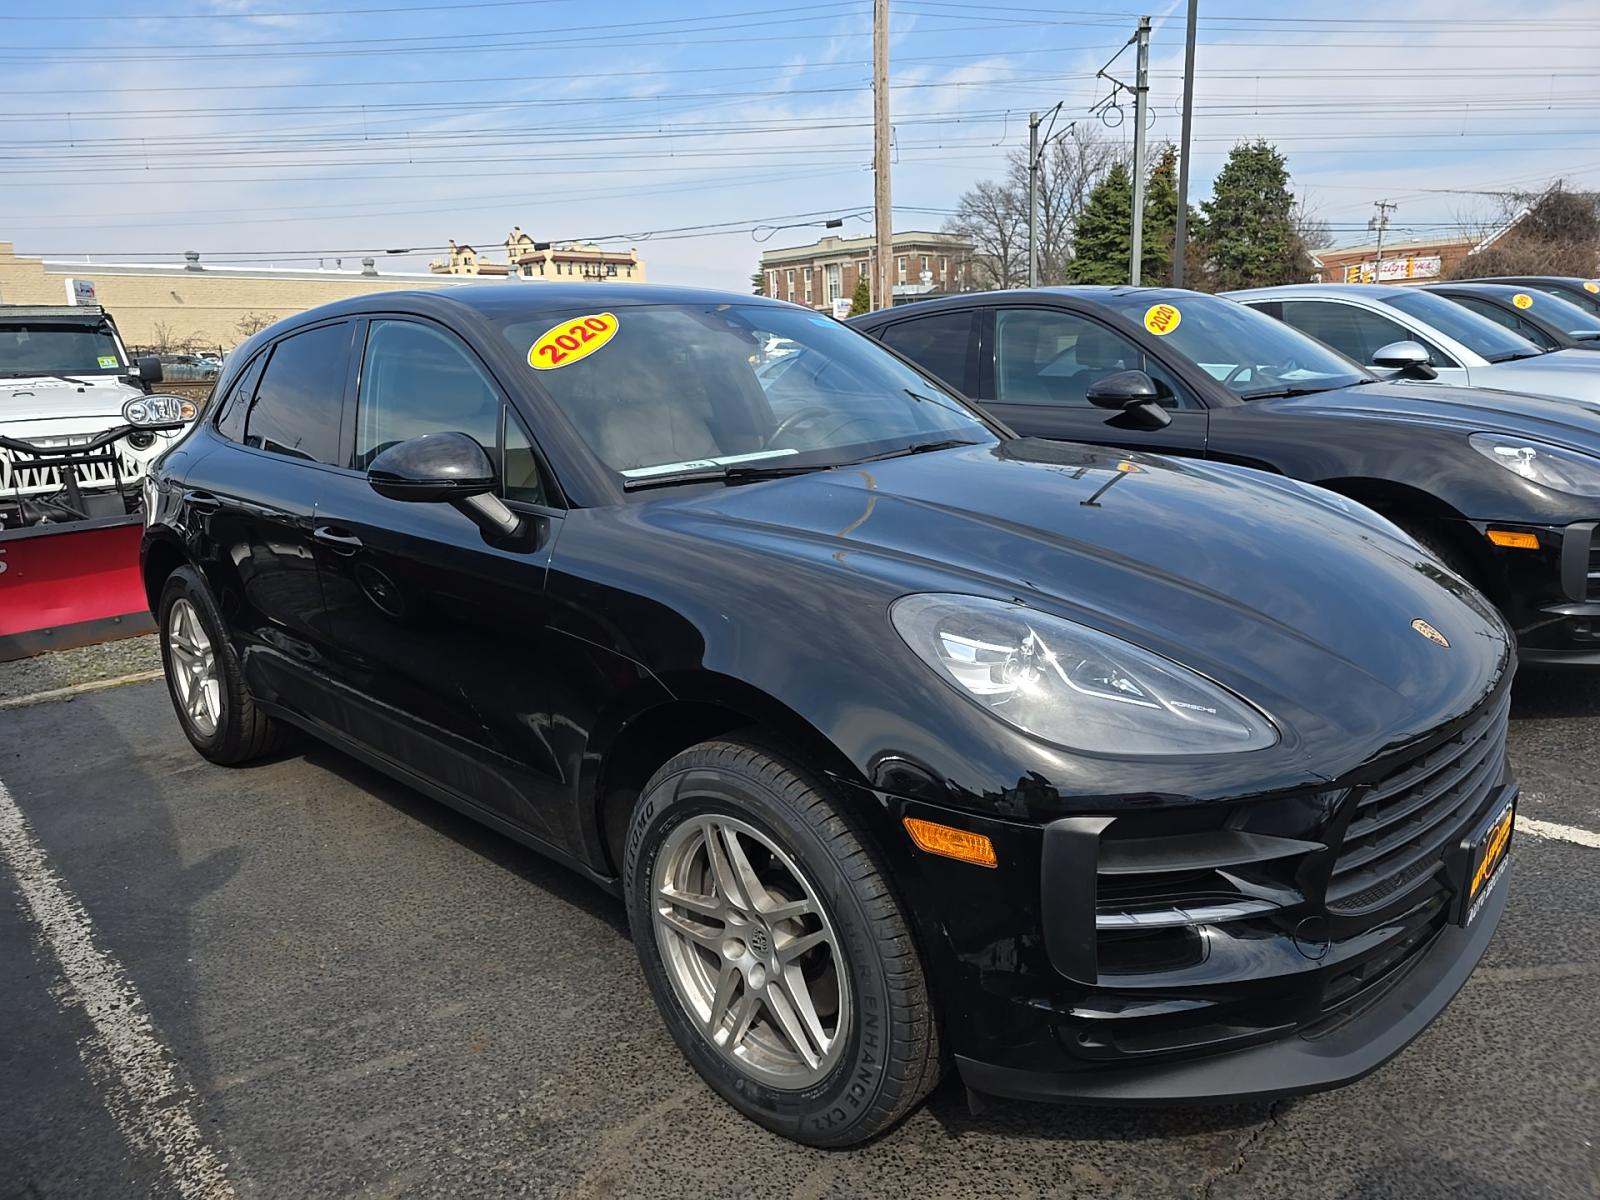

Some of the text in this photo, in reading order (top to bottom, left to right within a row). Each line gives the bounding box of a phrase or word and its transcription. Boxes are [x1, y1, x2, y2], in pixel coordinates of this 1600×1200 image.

[1150, 306, 1175, 332] 2020
[539, 317, 609, 364] 2020
[1170, 701, 1217, 714] PORSCHE
[846, 995, 879, 1109] ENHANCE
[811, 1107, 847, 1130] CX2
